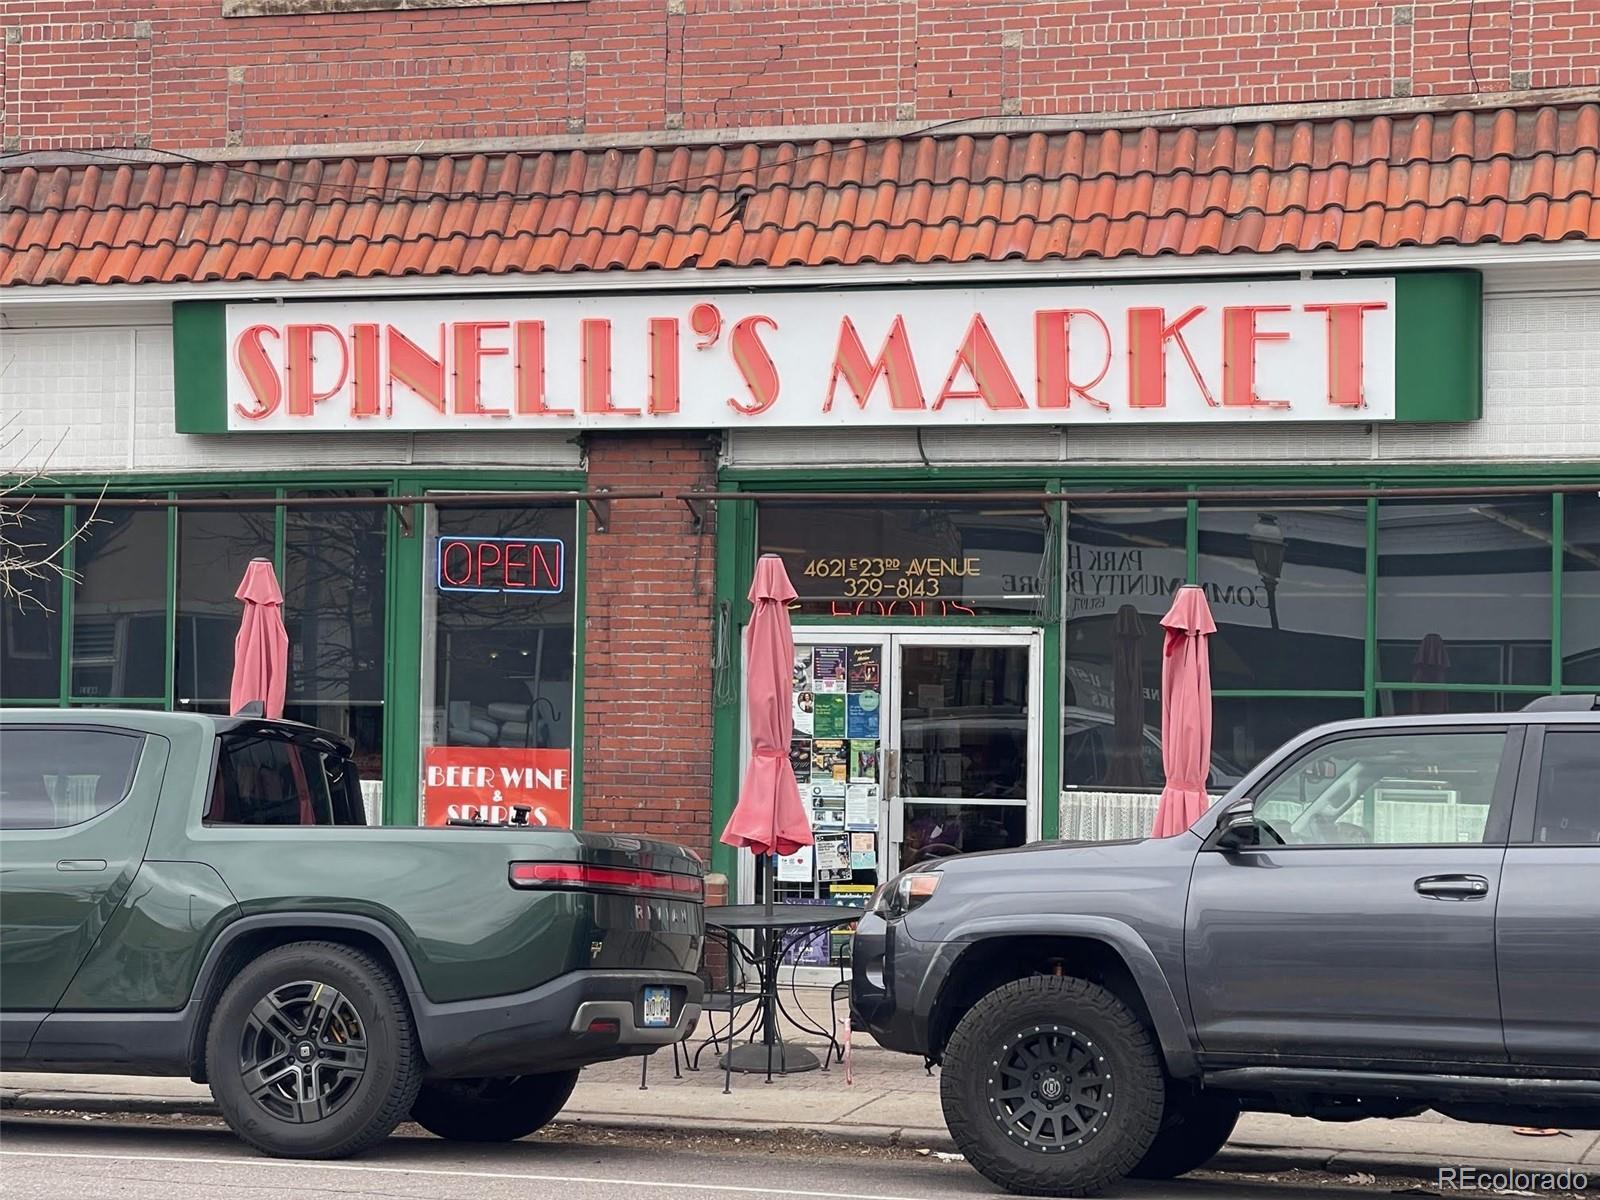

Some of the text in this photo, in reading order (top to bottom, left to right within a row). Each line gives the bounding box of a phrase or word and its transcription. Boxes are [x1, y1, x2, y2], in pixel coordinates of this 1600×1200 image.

[233, 301, 1388, 419] SPINELLI'S MARKET
[443, 541, 560, 587] OPEN
[804, 558, 846, 577] 4621
[905, 558, 981, 577] AVENUE
[843, 578, 940, 599] 329-8143
[427, 766, 569, 790] BEER WINE
[492, 789, 503, 802] &
